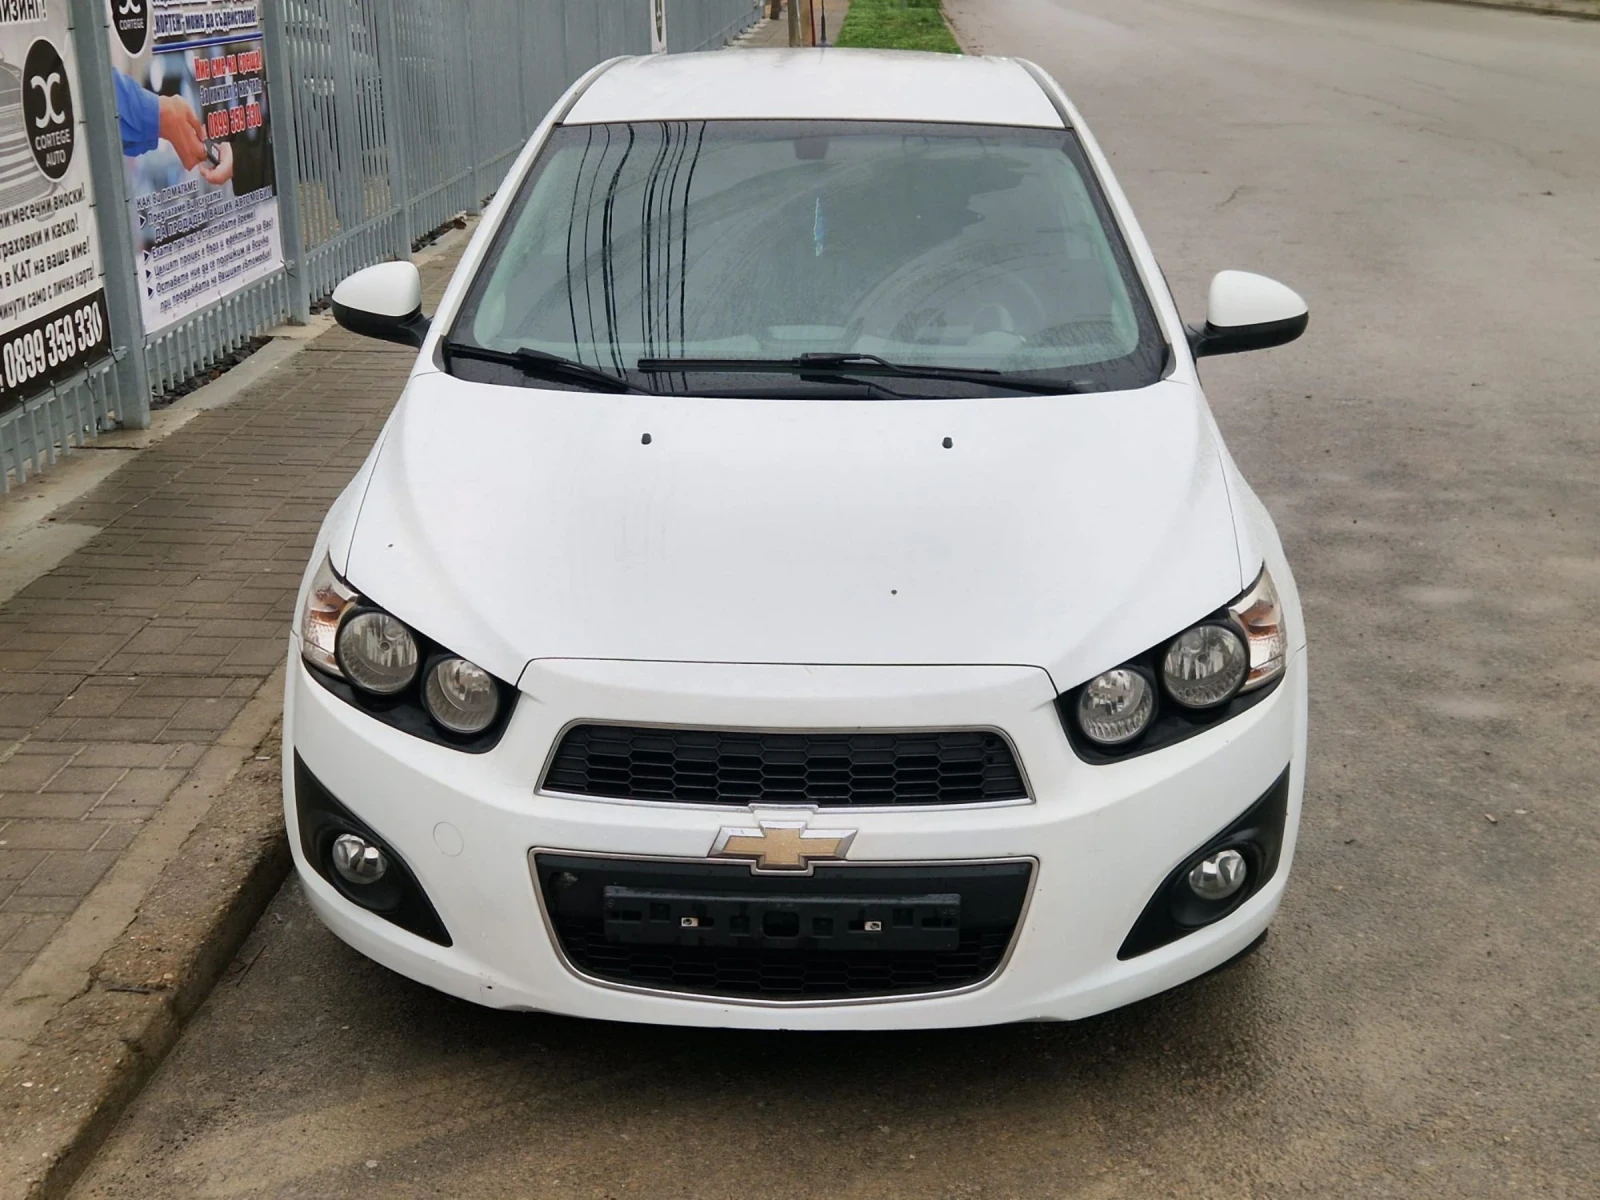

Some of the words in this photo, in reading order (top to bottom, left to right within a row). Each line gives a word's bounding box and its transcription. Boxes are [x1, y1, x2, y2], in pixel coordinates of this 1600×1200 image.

[119, 18, 145, 30] CORTEGE
[35, 129, 71, 150] CORTEGE
[208, 109, 230, 139] 0899
[230, 105, 246, 134] 359
[246, 101, 262, 129] 330
[46, 150, 66, 167] AUTO
[12, 198, 52, 224] месечни
[54, 182, 86, 211] вноски!
[155, 225, 167, 243] ДА
[168, 210, 208, 236] ПРОДАДЕМ
[209, 200, 233, 220] ВАШИЯ
[44, 227, 50, 243] и
[51, 212, 79, 240] каско!
[5, 271, 11, 287] в
[12, 259, 32, 284] КАТ
[33, 259, 45, 276] на
[46, 249, 70, 270] ваше
[70, 235, 90, 260] име!
[27, 287, 47, 308] само
[47, 284, 52, 300] с
[53, 275, 75, 297] лична
[75, 260, 96, 289] карта!
[3, 329, 46, 388] 0899
[45, 314, 77, 367] 359
[75, 301, 103, 351] 330
